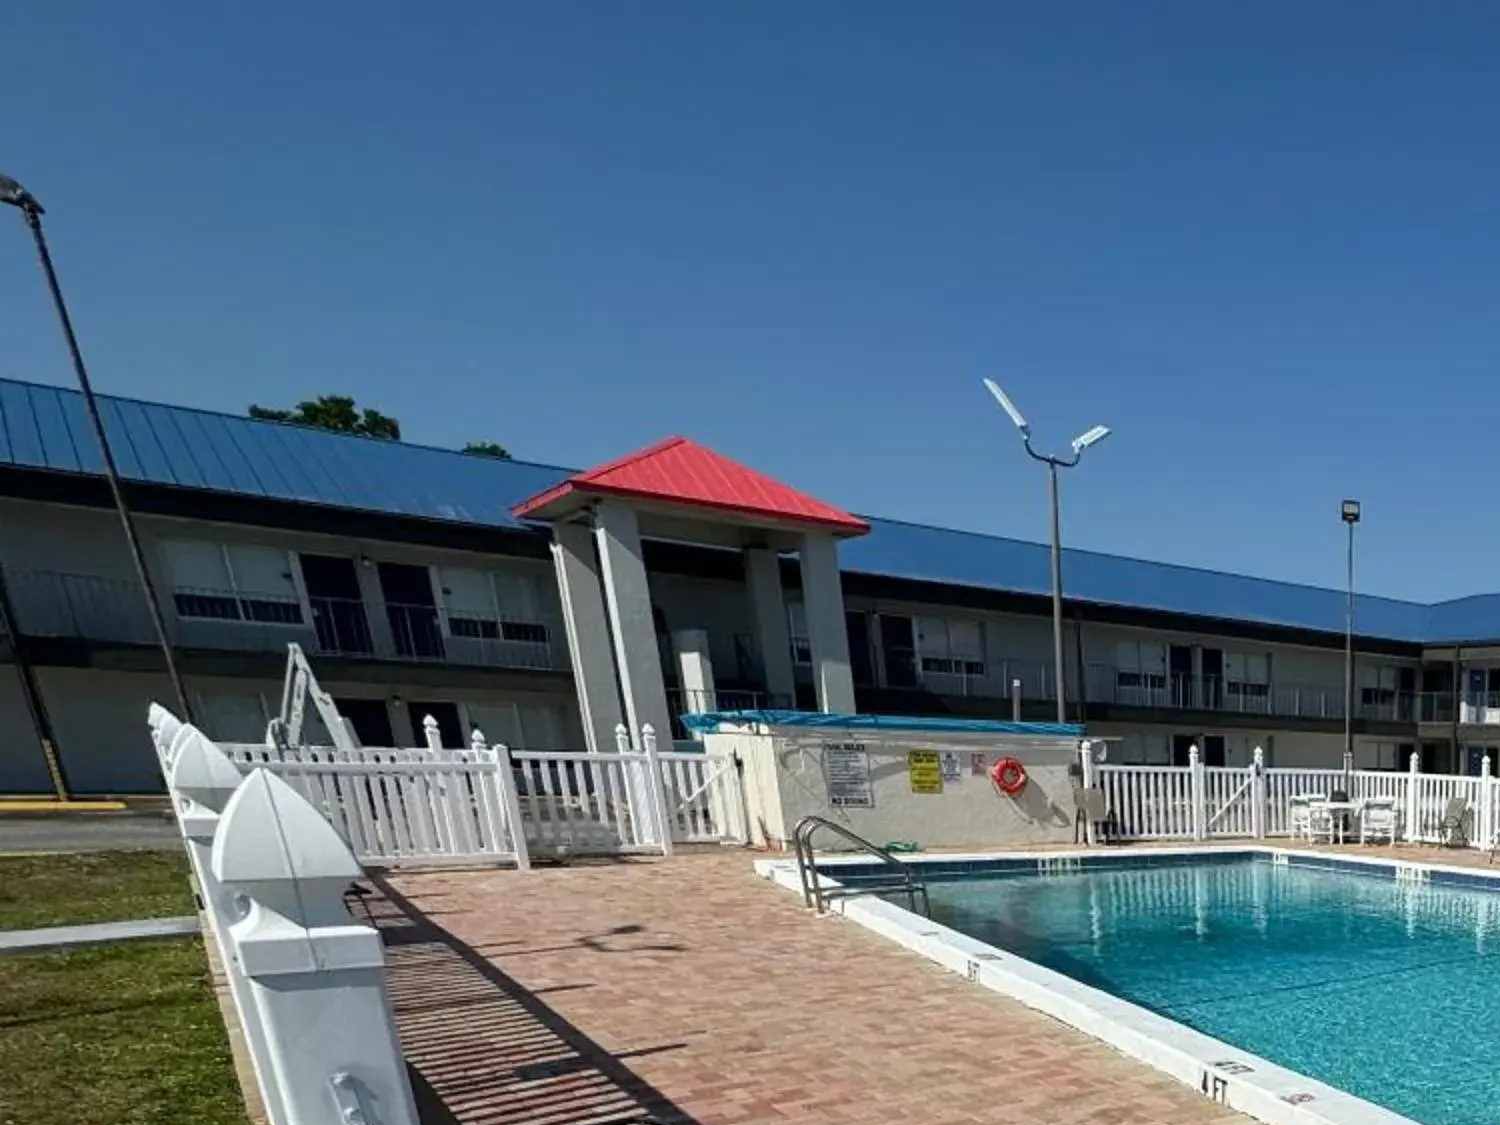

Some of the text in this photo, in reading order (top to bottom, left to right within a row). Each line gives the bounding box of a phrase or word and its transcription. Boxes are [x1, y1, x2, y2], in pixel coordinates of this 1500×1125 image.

[831, 797, 869, 805] NO DIVING
[1201, 1069, 1228, 1104] 4 FT
